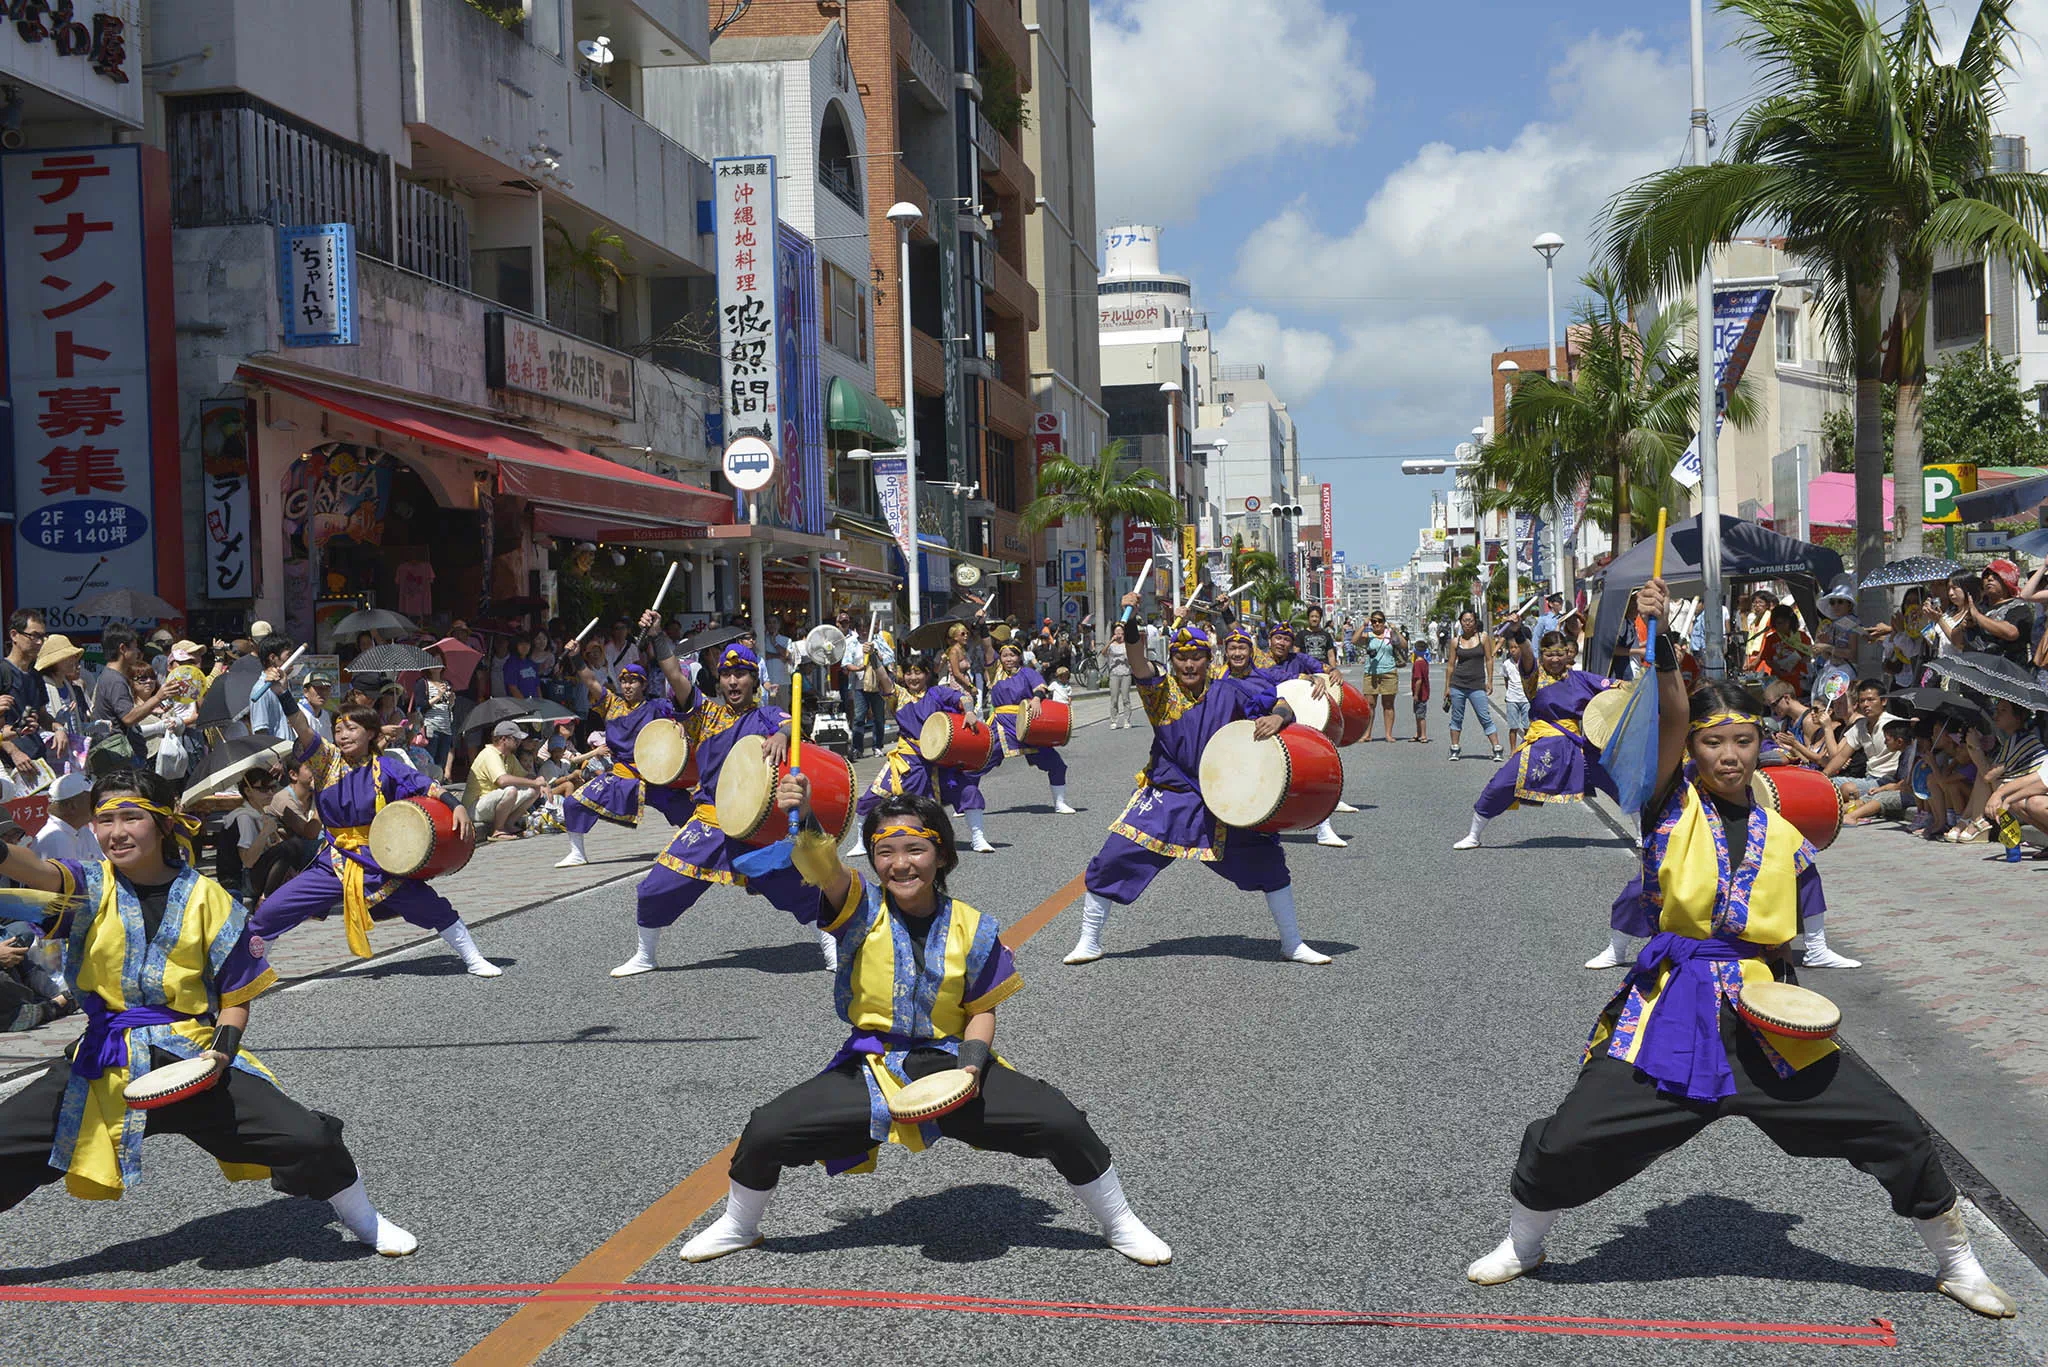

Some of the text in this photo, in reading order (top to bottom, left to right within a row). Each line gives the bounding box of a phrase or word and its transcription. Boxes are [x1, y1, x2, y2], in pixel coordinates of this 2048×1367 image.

[719, 163, 768, 177] 木本興産
[733, 182, 757, 292] 沖縄地料理
[300, 247, 323, 326] ちゃんや
[31, 154, 128, 496] テナント募集
[724, 294, 772, 416] 波照間
[40, 507, 127, 526] 2F 94坪
[1323, 487, 1331, 538] MITSUKOSHI
[1924, 476, 1953, 513] P
[40, 526, 128, 545] 6F 140坪
[213, 472, 244, 591] ラーメン
[1065, 552, 1085, 580] P
[1748, 562, 1806, 575] CAPTAIN STAG
